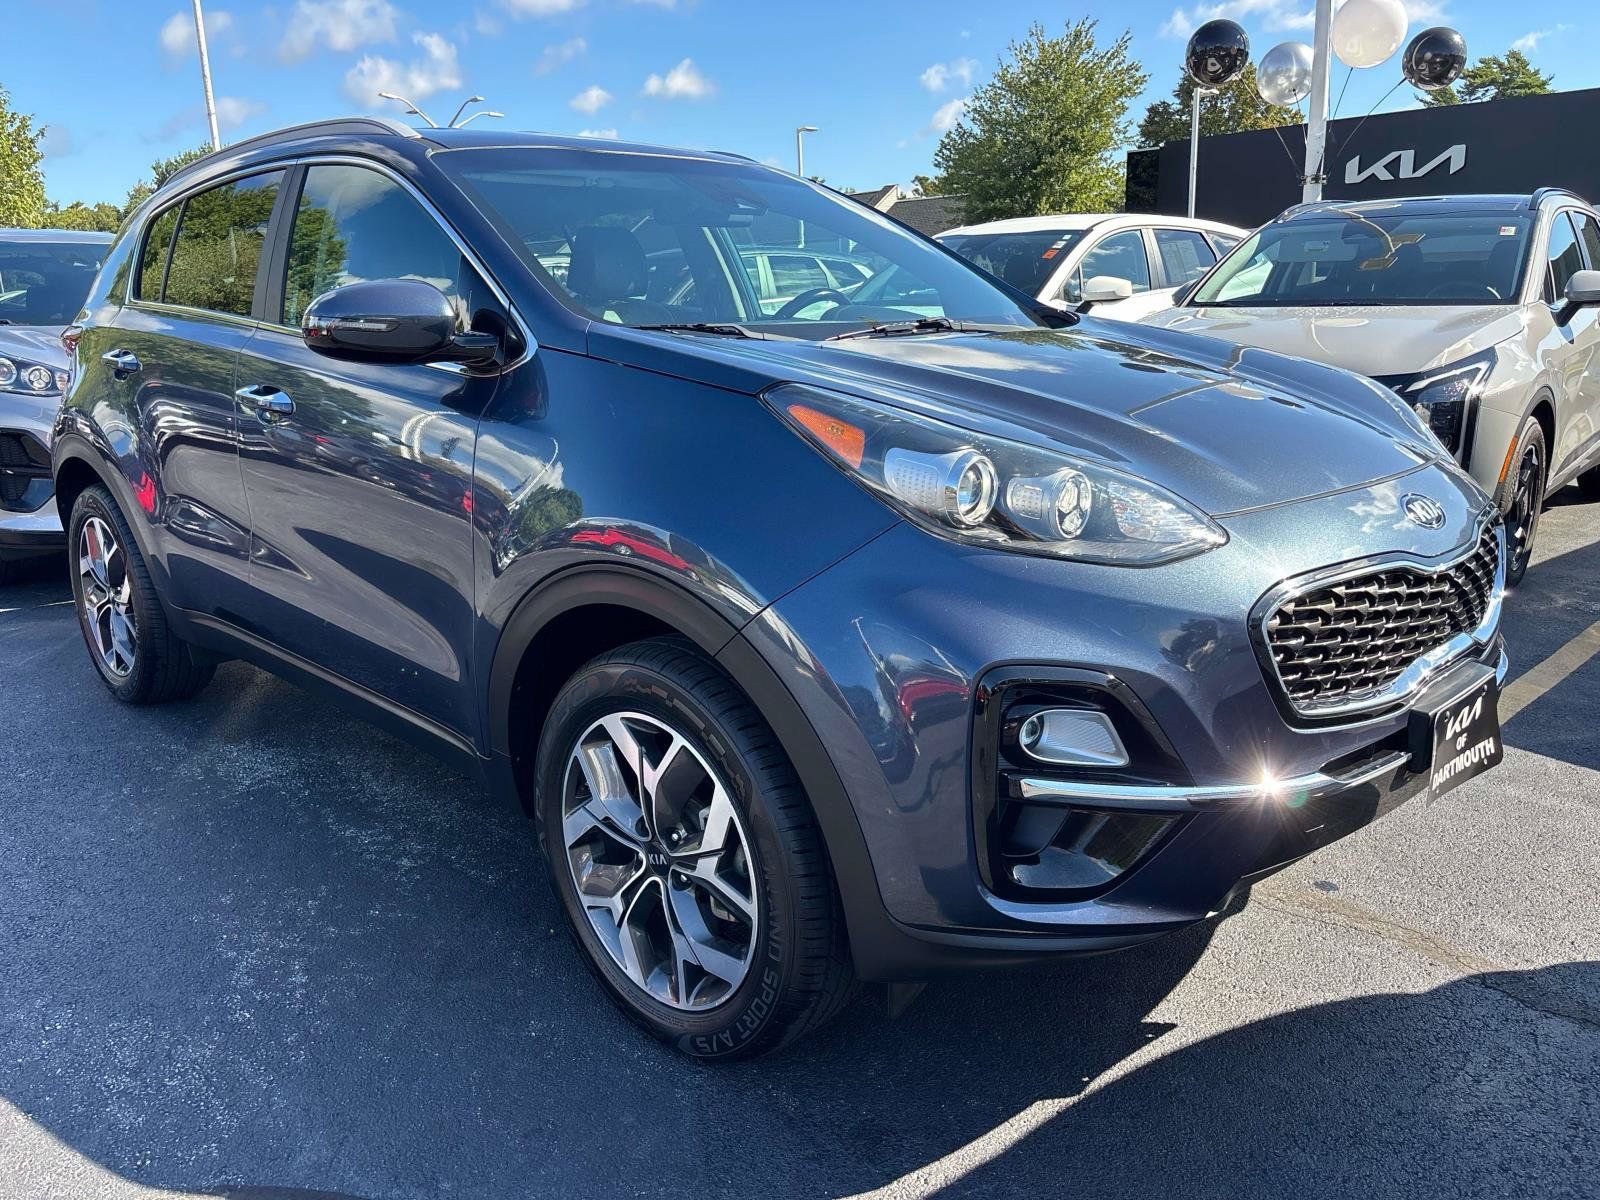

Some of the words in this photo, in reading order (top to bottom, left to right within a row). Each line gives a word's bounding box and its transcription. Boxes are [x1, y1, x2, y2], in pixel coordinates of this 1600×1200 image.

[1345, 144, 1466, 184] KIA
[1445, 697, 1483, 740] KIA
[1456, 733, 1468, 750] OF
[1432, 736, 1496, 791] DARTMOUTH
[649, 853, 667, 865] KIA
[736, 966, 779, 1039] SPORT
[695, 1029, 734, 1053] A/S
